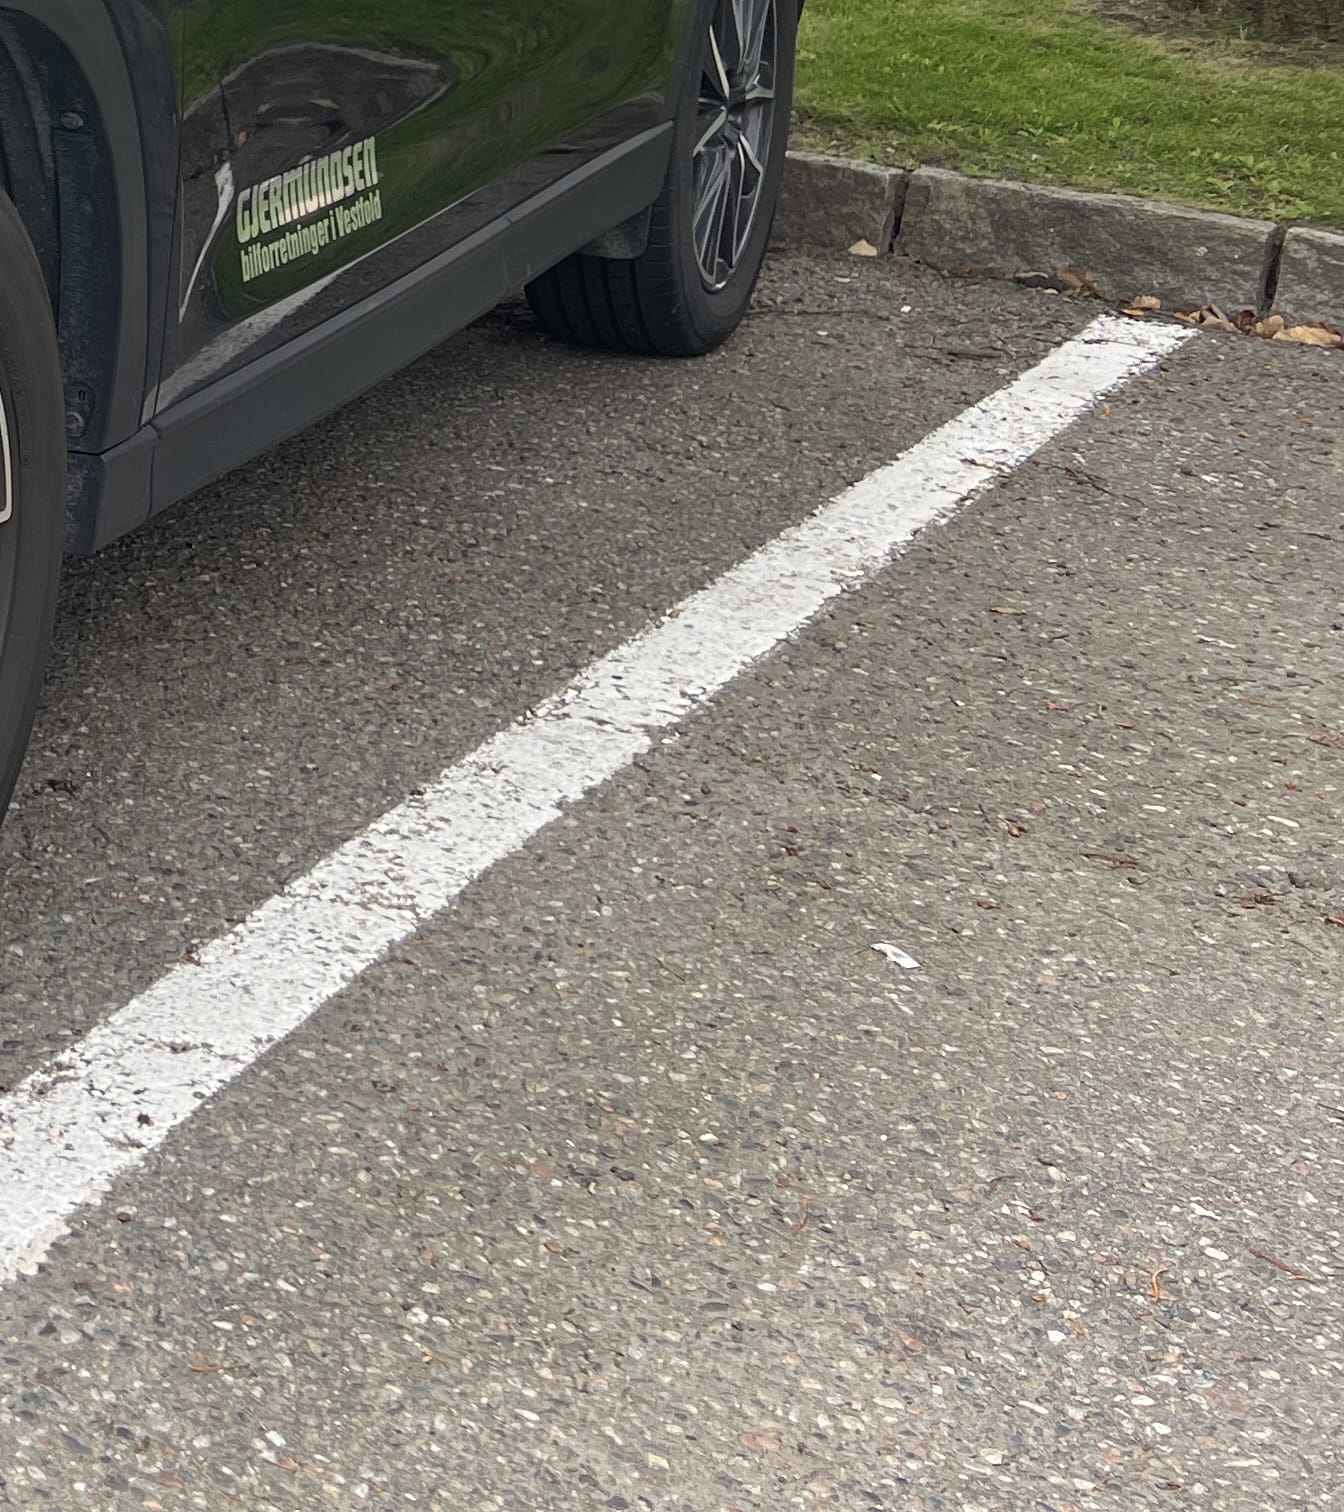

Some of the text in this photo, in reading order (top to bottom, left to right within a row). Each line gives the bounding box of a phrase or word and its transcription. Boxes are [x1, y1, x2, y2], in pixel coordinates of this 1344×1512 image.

[240, 188, 382, 283] bilforretninger i Vestfold
